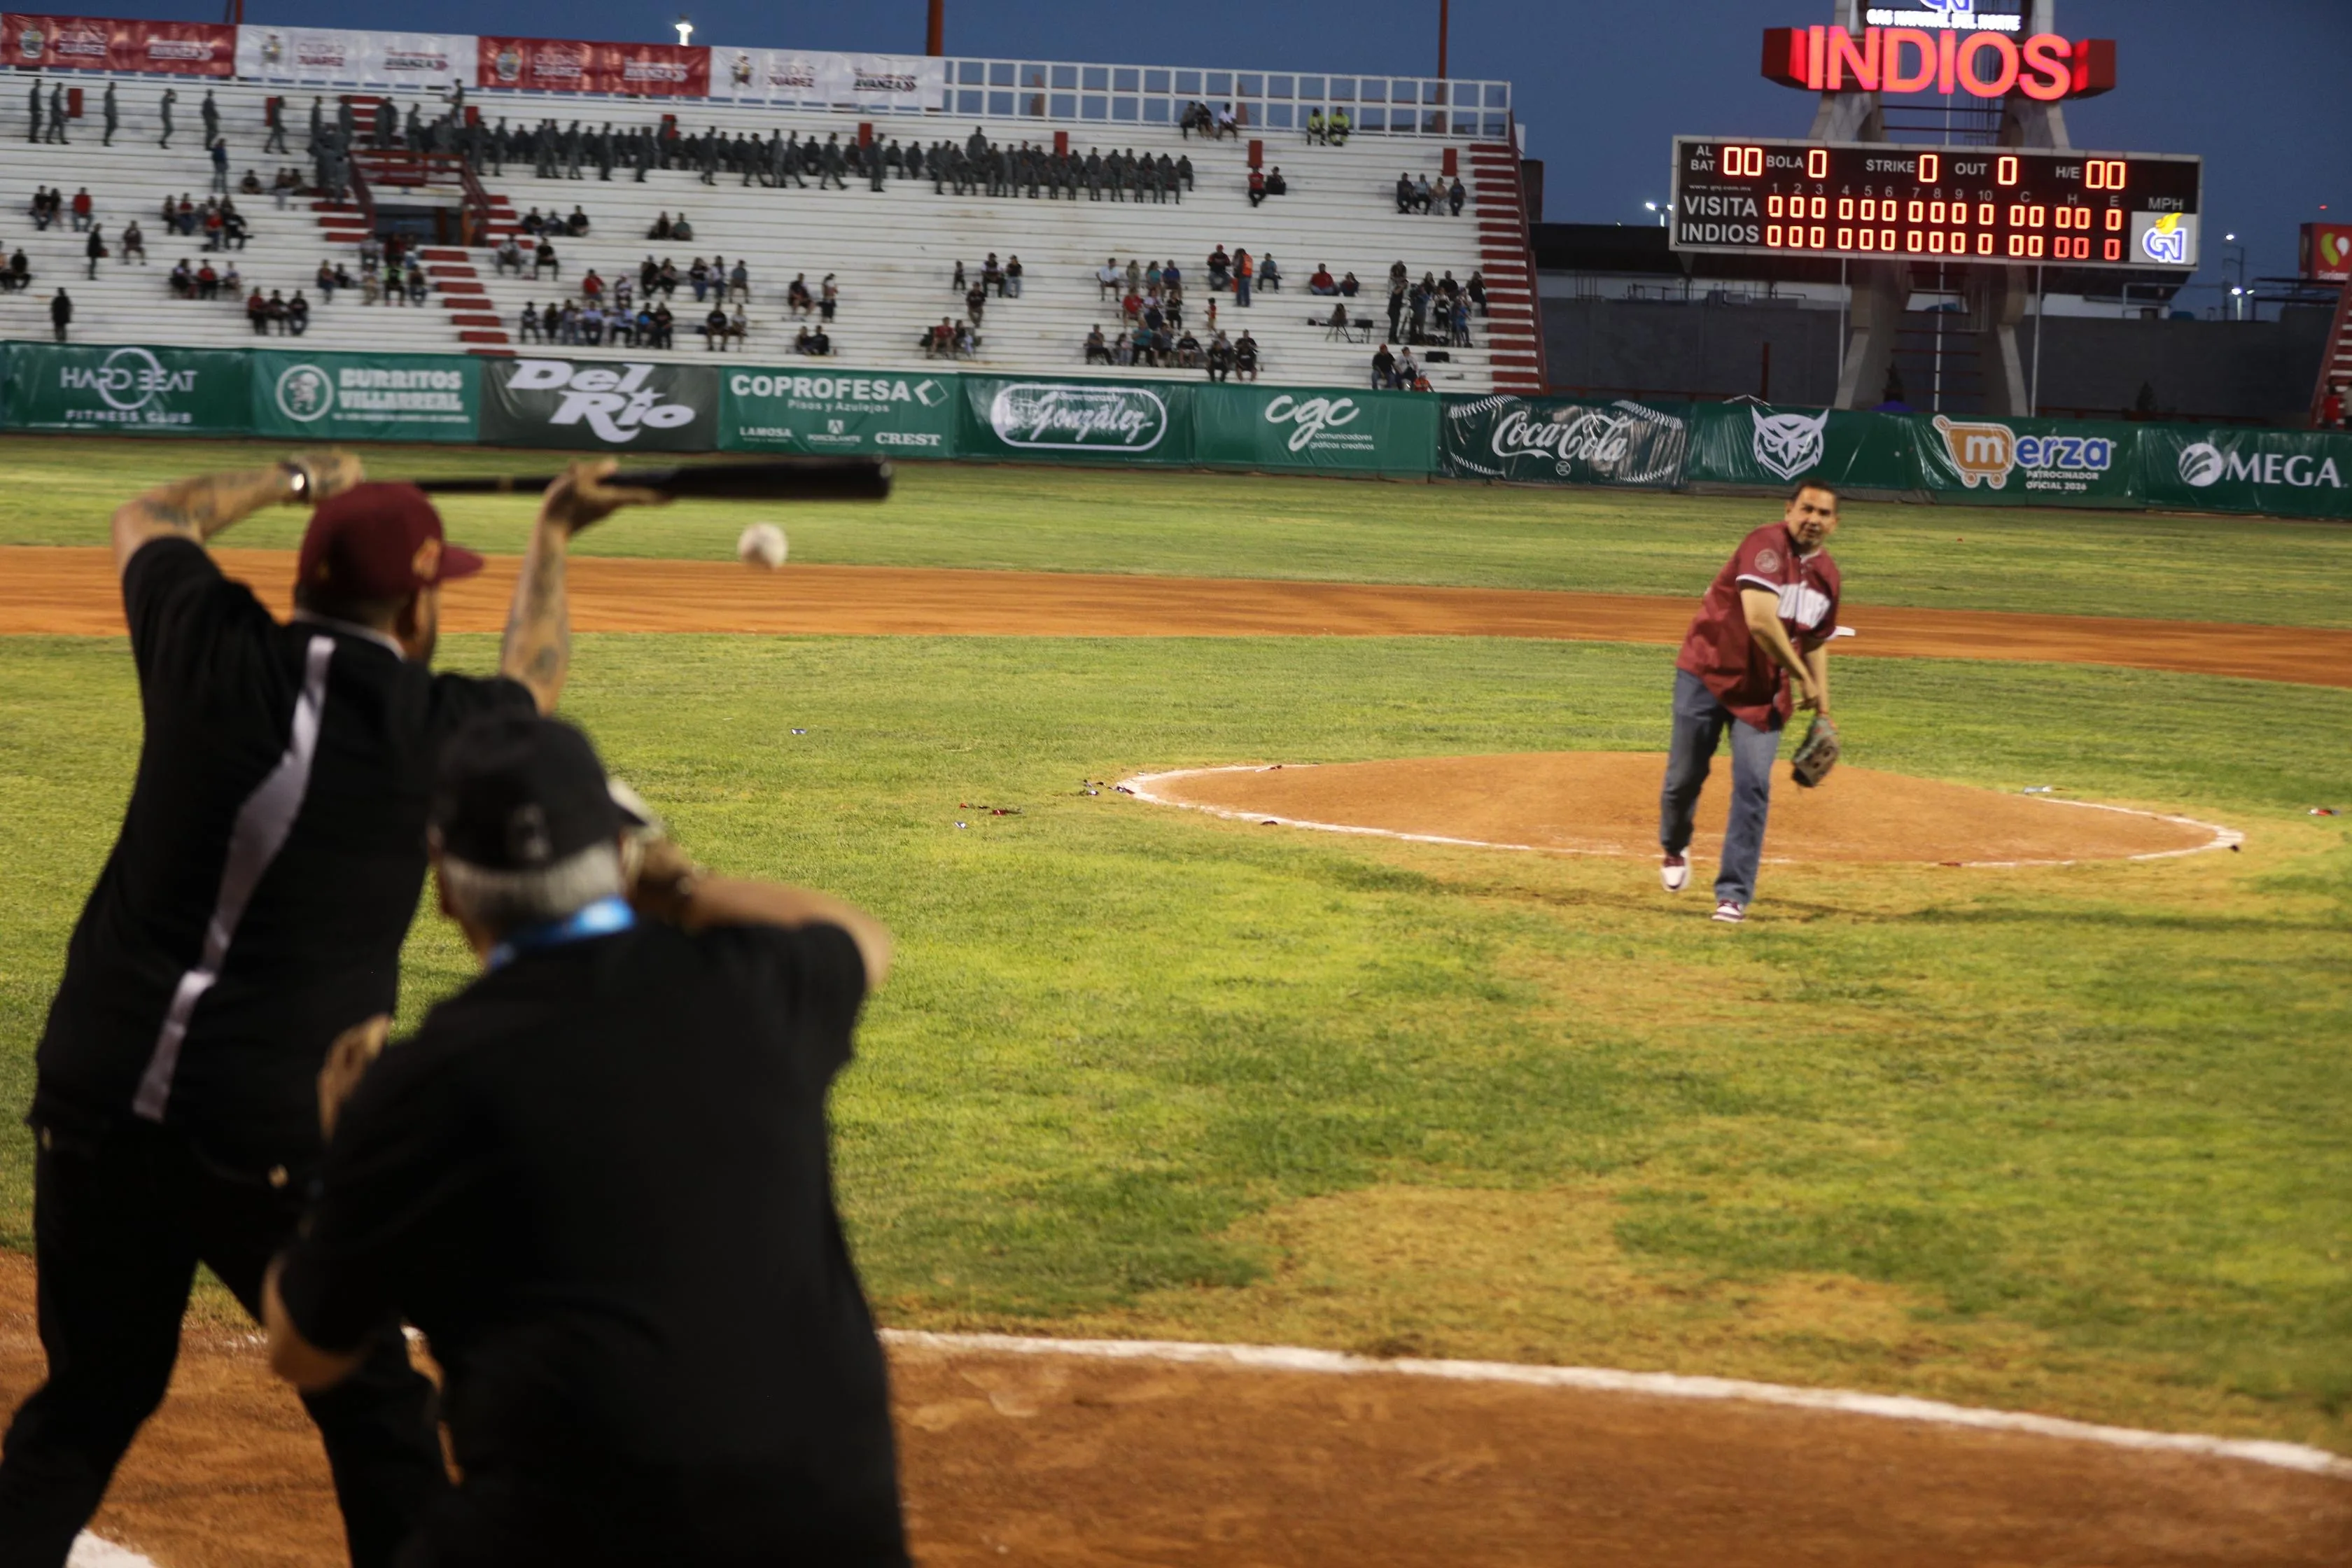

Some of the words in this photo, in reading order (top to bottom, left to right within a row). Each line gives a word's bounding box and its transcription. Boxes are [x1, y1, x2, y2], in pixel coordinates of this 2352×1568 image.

[1807, 25, 2072, 100] INDIOS
[854, 78, 902, 90] AVANZA
[1695, 145, 1713, 157] AL
[1723, 147, 1763, 176] 00
[1766, 155, 1804, 169] BOLA
[1690, 160, 1715, 172] BAT
[1808, 150, 1827, 178] 0
[1865, 160, 1915, 173] STRIKE
[1919, 155, 1938, 182] 0
[1954, 162, 1988, 175] OUT
[1998, 157, 2017, 185] 0
[2055, 167, 2080, 179] H/E
[2086, 160, 2125, 190] 00
[1772, 183, 1779, 193] 1
[1793, 183, 1802, 195] 2
[1815, 184, 1823, 195] 3
[1842, 185, 1850, 196] 4
[1864, 186, 1872, 197] 5
[1884, 186, 1893, 197] 6
[1912, 188, 1921, 199] 7
[1933, 188, 1942, 199] 8
[1954, 189, 1963, 200] 9
[1978, 190, 1993, 202] 10
[2020, 191, 2031, 203] C
[2067, 194, 2078, 205] H
[2110, 195, 2120, 207] E
[2148, 197, 2183, 211] MPH
[1684, 196, 1758, 218] VISITA
[1768, 196, 1783, 218] 0
[1789, 197, 1805, 218] 0
[1811, 197, 1826, 219] 0
[1838, 199, 1854, 220] 0
[1860, 200, 1875, 220] 0
[1882, 200, 1897, 221] 0
[1908, 202, 1924, 223] 0
[1930, 202, 1945, 223] 0
[1952, 203, 1967, 224] 0
[1978, 204, 1994, 225] 0
[1681, 223, 1760, 243] INDIOS
[1767, 225, 1782, 247] 0
[1788, 226, 1803, 248] 0
[1809, 227, 1825, 248] 0
[1837, 228, 1853, 250] 0
[1859, 229, 1874, 251] 0
[1880, 230, 1896, 251] 0
[1907, 231, 1923, 252] 0
[1928, 232, 1944, 253] 0
[1950, 232, 1966, 253] 0
[1977, 233, 1993, 255] 0
[60, 367, 133, 390] HARD
[137, 370, 198, 391] BEAT
[340, 368, 462, 389] BURRITOS
[506, 360, 655, 392] Del
[730, 374, 912, 402] COPROFESA
[66, 409, 139, 422] FITNESS
[146, 412, 192, 423] CLUB
[788, 400, 822, 410] Pisos
[825, 401, 832, 412] y
[835, 402, 890, 413] Azulejos
[740, 426, 793, 438] LAMOSA
[1030, 398, 1154, 444] González
[1265, 395, 1360, 451] cgc
[875, 432, 942, 445] CREST
[1315, 433, 1373, 441] comunicadores
[1492, 411, 1630, 462] Coca-Cola
[1964, 433, 2112, 471] merza
[2026, 470, 2099, 480] PATROCINADOR
[2225, 450, 2342, 488] MEGA
[2026, 481, 2062, 490] OFICIAL
